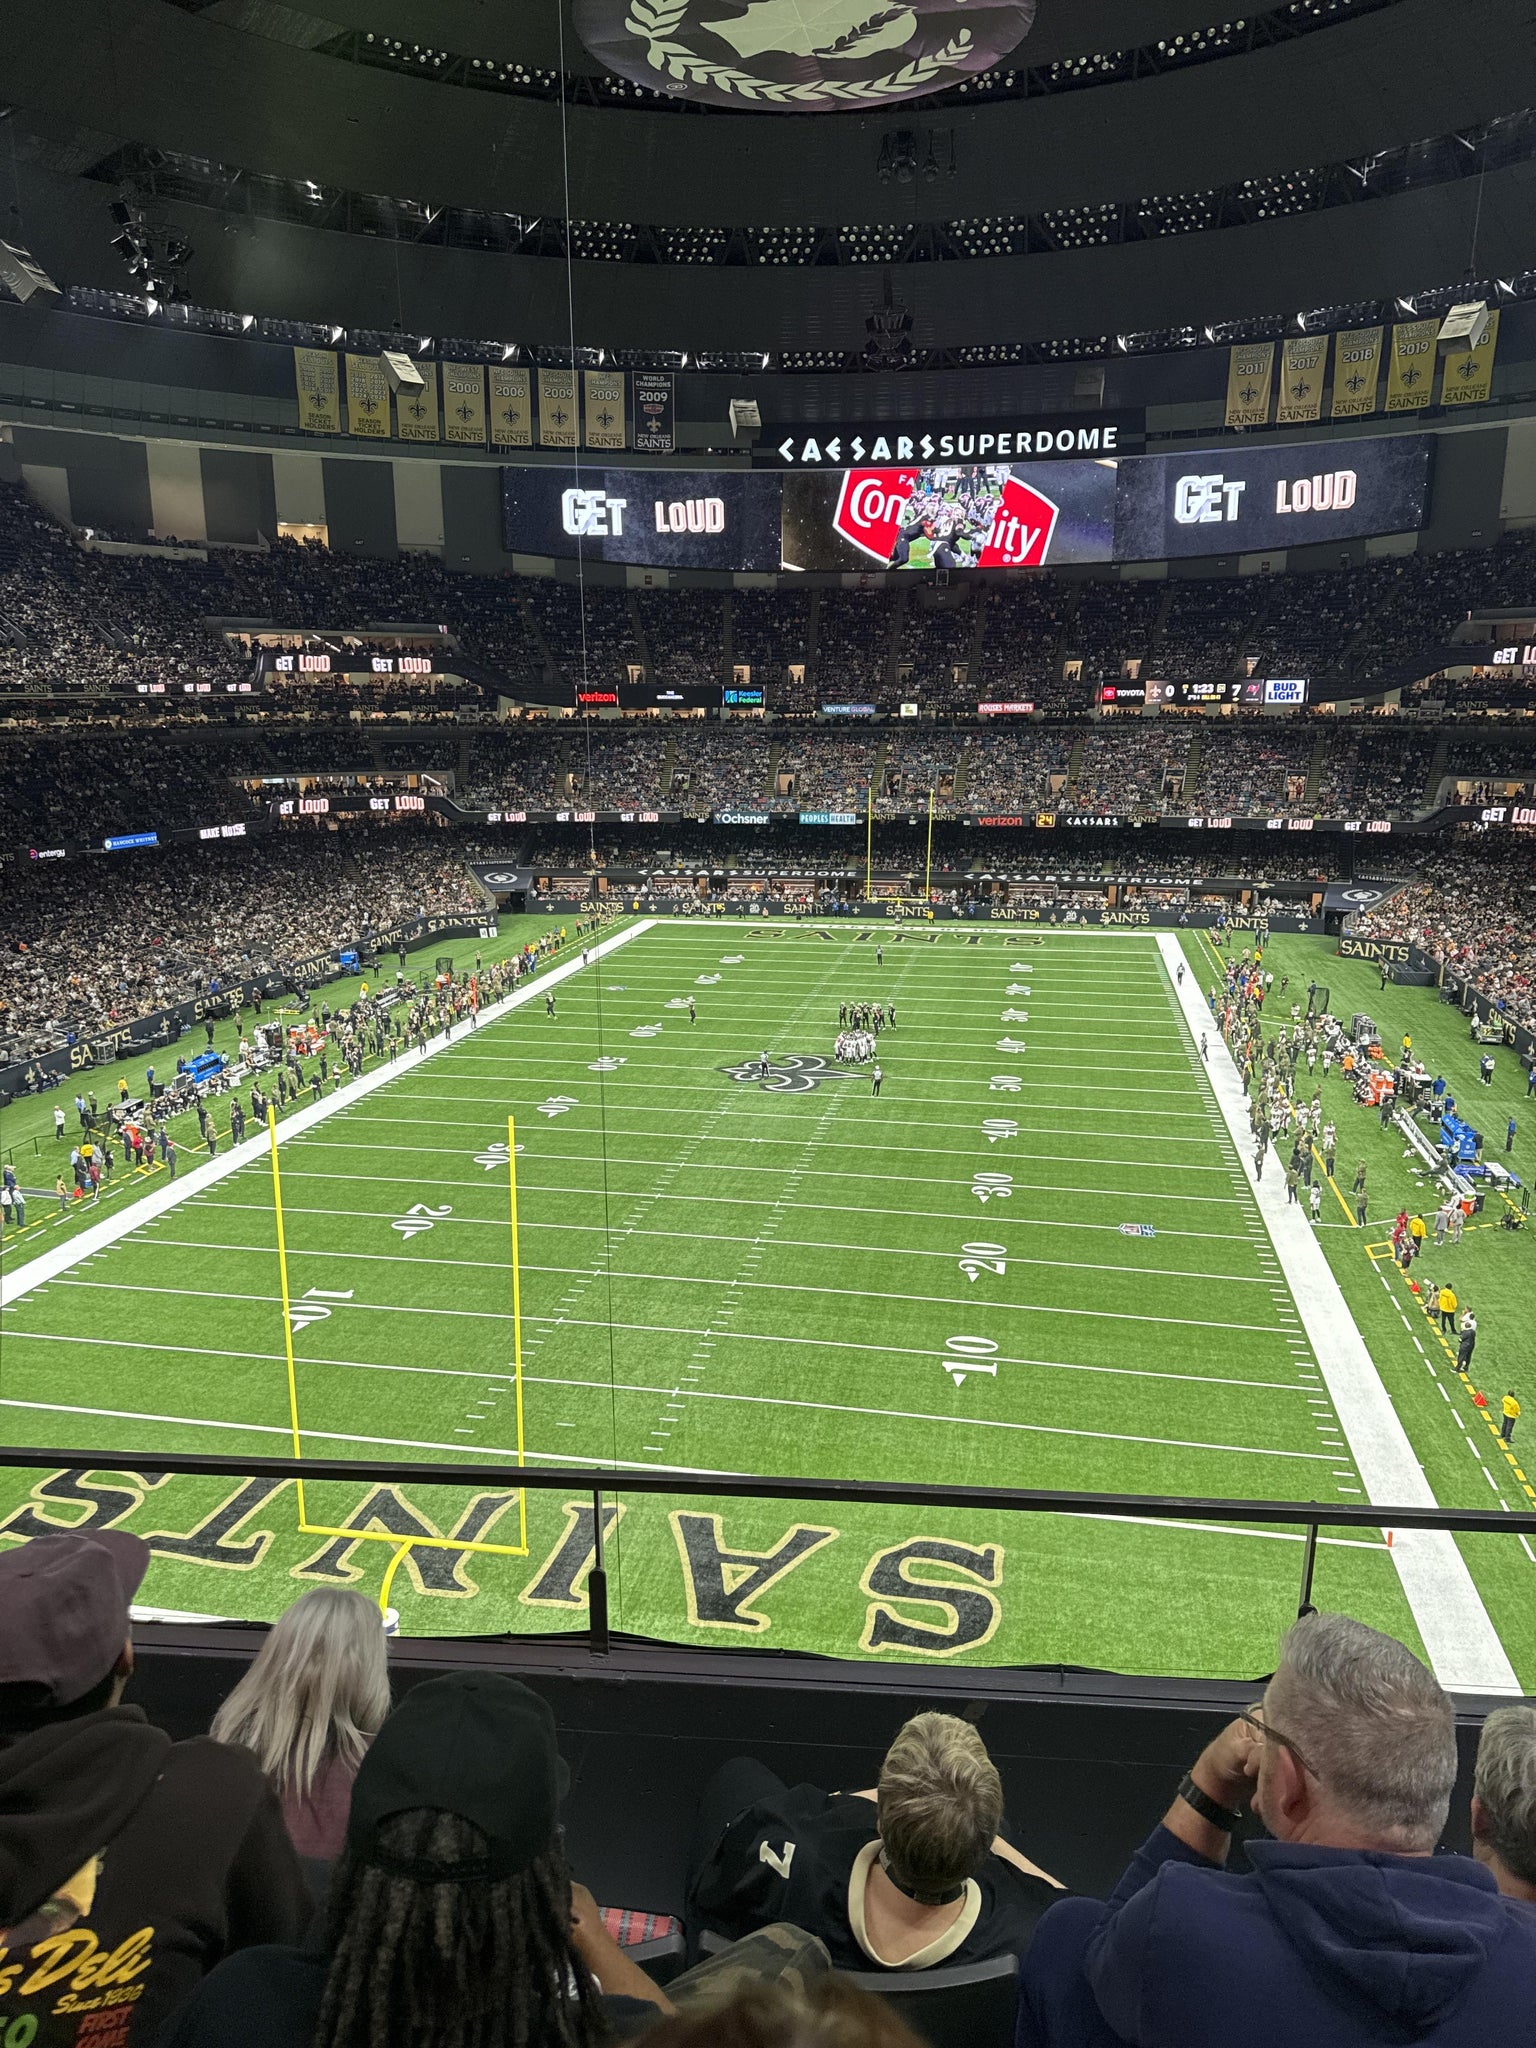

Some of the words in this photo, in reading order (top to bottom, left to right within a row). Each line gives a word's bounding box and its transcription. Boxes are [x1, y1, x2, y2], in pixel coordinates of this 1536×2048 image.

[1398, 341, 1429, 356] 2019
[1342, 348, 1373, 363] 2018
[1238, 362, 1264, 376] 2011
[1289, 356, 1318, 371] 2017
[449, 381, 479, 394] 2000
[495, 386, 525, 397] 2006
[544, 387, 574, 399] 2009
[590, 389, 620, 401] 2009
[639, 391, 668, 402] 2009
[1444, 390, 1486, 402] SAINTS
[1334, 401, 1373, 416] SAINTS
[1388, 396, 1428, 409] SAINTS
[1228, 413, 1265, 425] SAINTS
[1280, 409, 1317, 421] SAINTS
[402, 428, 436, 439] SAINTS
[448, 430, 483, 441] SAINTS
[495, 434, 529, 443] SAINTS
[588, 437, 623, 447] SAINTS
[637, 439, 671, 448] SAINTS
[778, 434, 936, 462] CAESARS
[939, 427, 1118, 456] SUPERDOME
[1174, 474, 1246, 525] GET
[1276, 470, 1357, 514] LOUD
[562, 488, 627, 536] GET
[654, 498, 725, 534] LOUD
[1493, 647, 1518, 664] GET
[276, 656, 293, 672] GET
[299, 654, 331, 672] LOUD
[372, 657, 394, 672] GET
[399, 657, 432, 673] LOUD
[24, 684, 52, 693] SAINTS
[1273, 682, 1296, 692] BUD
[578, 692, 616, 702] verizon
[1268, 692, 1301, 701] LIGHT
[823, 705, 851, 713] VENTURE
[280, 801, 294, 815] GET
[299, 798, 329, 814] LOUD
[370, 798, 390, 810] GET
[395, 796, 425, 810] LOUD
[488, 813, 501, 822] GET
[505, 812, 527, 822] LOUD
[556, 813, 570, 822] GET
[574, 812, 595, 822] LOUD
[620, 813, 635, 822] GET
[638, 812, 658, 822] LOUD
[721, 813, 768, 824] Ochsner
[800, 814, 828, 823] PEOPLES
[830, 814, 856, 824] HEALTH
[1038, 815, 1053, 825] 24
[1481, 807, 1507, 821] GET
[978, 816, 1023, 826] verizon
[1066, 817, 1118, 826] CAESARS
[1188, 818, 1204, 828] GET
[1207, 818, 1232, 828] LOUD
[1267, 819, 1283, 829] GET
[1288, 819, 1314, 830] LOUD
[1344, 821, 1361, 831] GET
[1366, 821, 1391, 833] LOUD
[221, 824, 246, 837] NOISE
[39, 849, 66, 858] entergy
[1076, 876, 1204, 885] SUPERDOME
[1100, 912, 1150, 923] SAINTS
[1224, 916, 1268, 929] AINTS
[744, 929, 1046, 948] SAINTS
[1341, 940, 1410, 962] SAINTS
[588, 1056, 628, 1072] 50
[989, 1075, 1023, 1092] 50
[981, 1119, 1018, 1138] 40
[473, 1142, 525, 1165] 30
[971, 1172, 1014, 1197] 30
[392, 1203, 453, 1231] 20
[958, 1242, 1007, 1275] 20
[282, 1287, 355, 1321] 10
[942, 1335, 998, 1376] 10
[0, 1466, 1004, 1658] SAINTS
[18, 1926, 155, 1996] Deli
